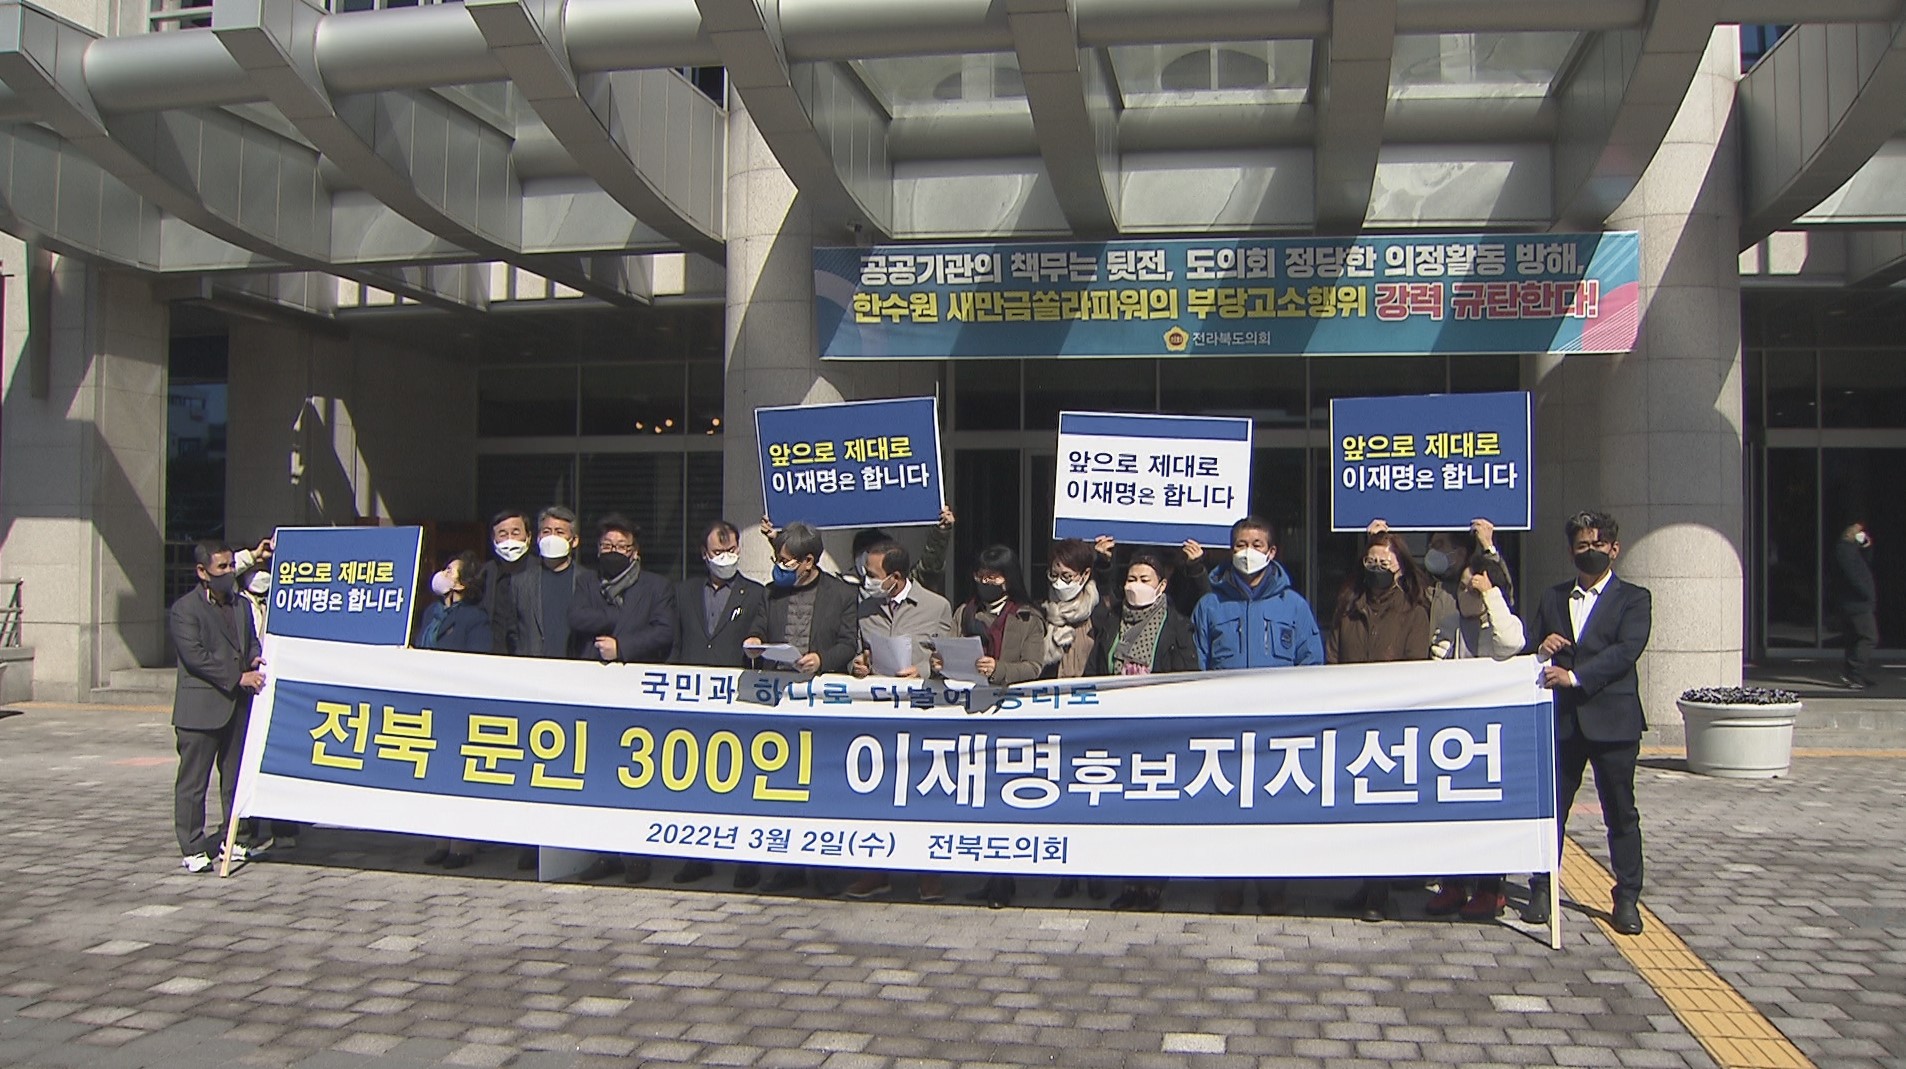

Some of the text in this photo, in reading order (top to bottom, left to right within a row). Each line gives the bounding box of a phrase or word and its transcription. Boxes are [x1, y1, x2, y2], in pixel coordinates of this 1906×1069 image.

[860, 242, 1585, 286] 공공기관의 책무는 뒷전, 도의회 정당한 의정활동 방해,
[852, 280, 1600, 323] 한수원 새만금쏠라파워의 부당고소행위 강력 규탄한다!
[1192, 331, 1271, 346] 전라북도의회
[769, 436, 913, 467] 앞으로 제대로
[1342, 431, 1501, 461] 앞으로 제대로
[772, 462, 930, 495] 이재명은 합니다
[1069, 450, 1220, 478] 앞으로 제대로
[1342, 461, 1518, 492] 이재명은 합니다
[1067, 479, 1235, 509] 이재명은 합니다
[279, 560, 394, 585] 앞으로 제대로
[275, 587, 404, 612] 이재명은 합니다
[641, 671, 735, 704] 국민과
[753, 677, 852, 707] 하나로
[309, 700, 437, 778] 전북
[460, 713, 588, 791] 문인
[617, 726, 813, 802] 300인
[645, 823, 1069, 864] 2022년 3월 2일(수) 전북도의회
